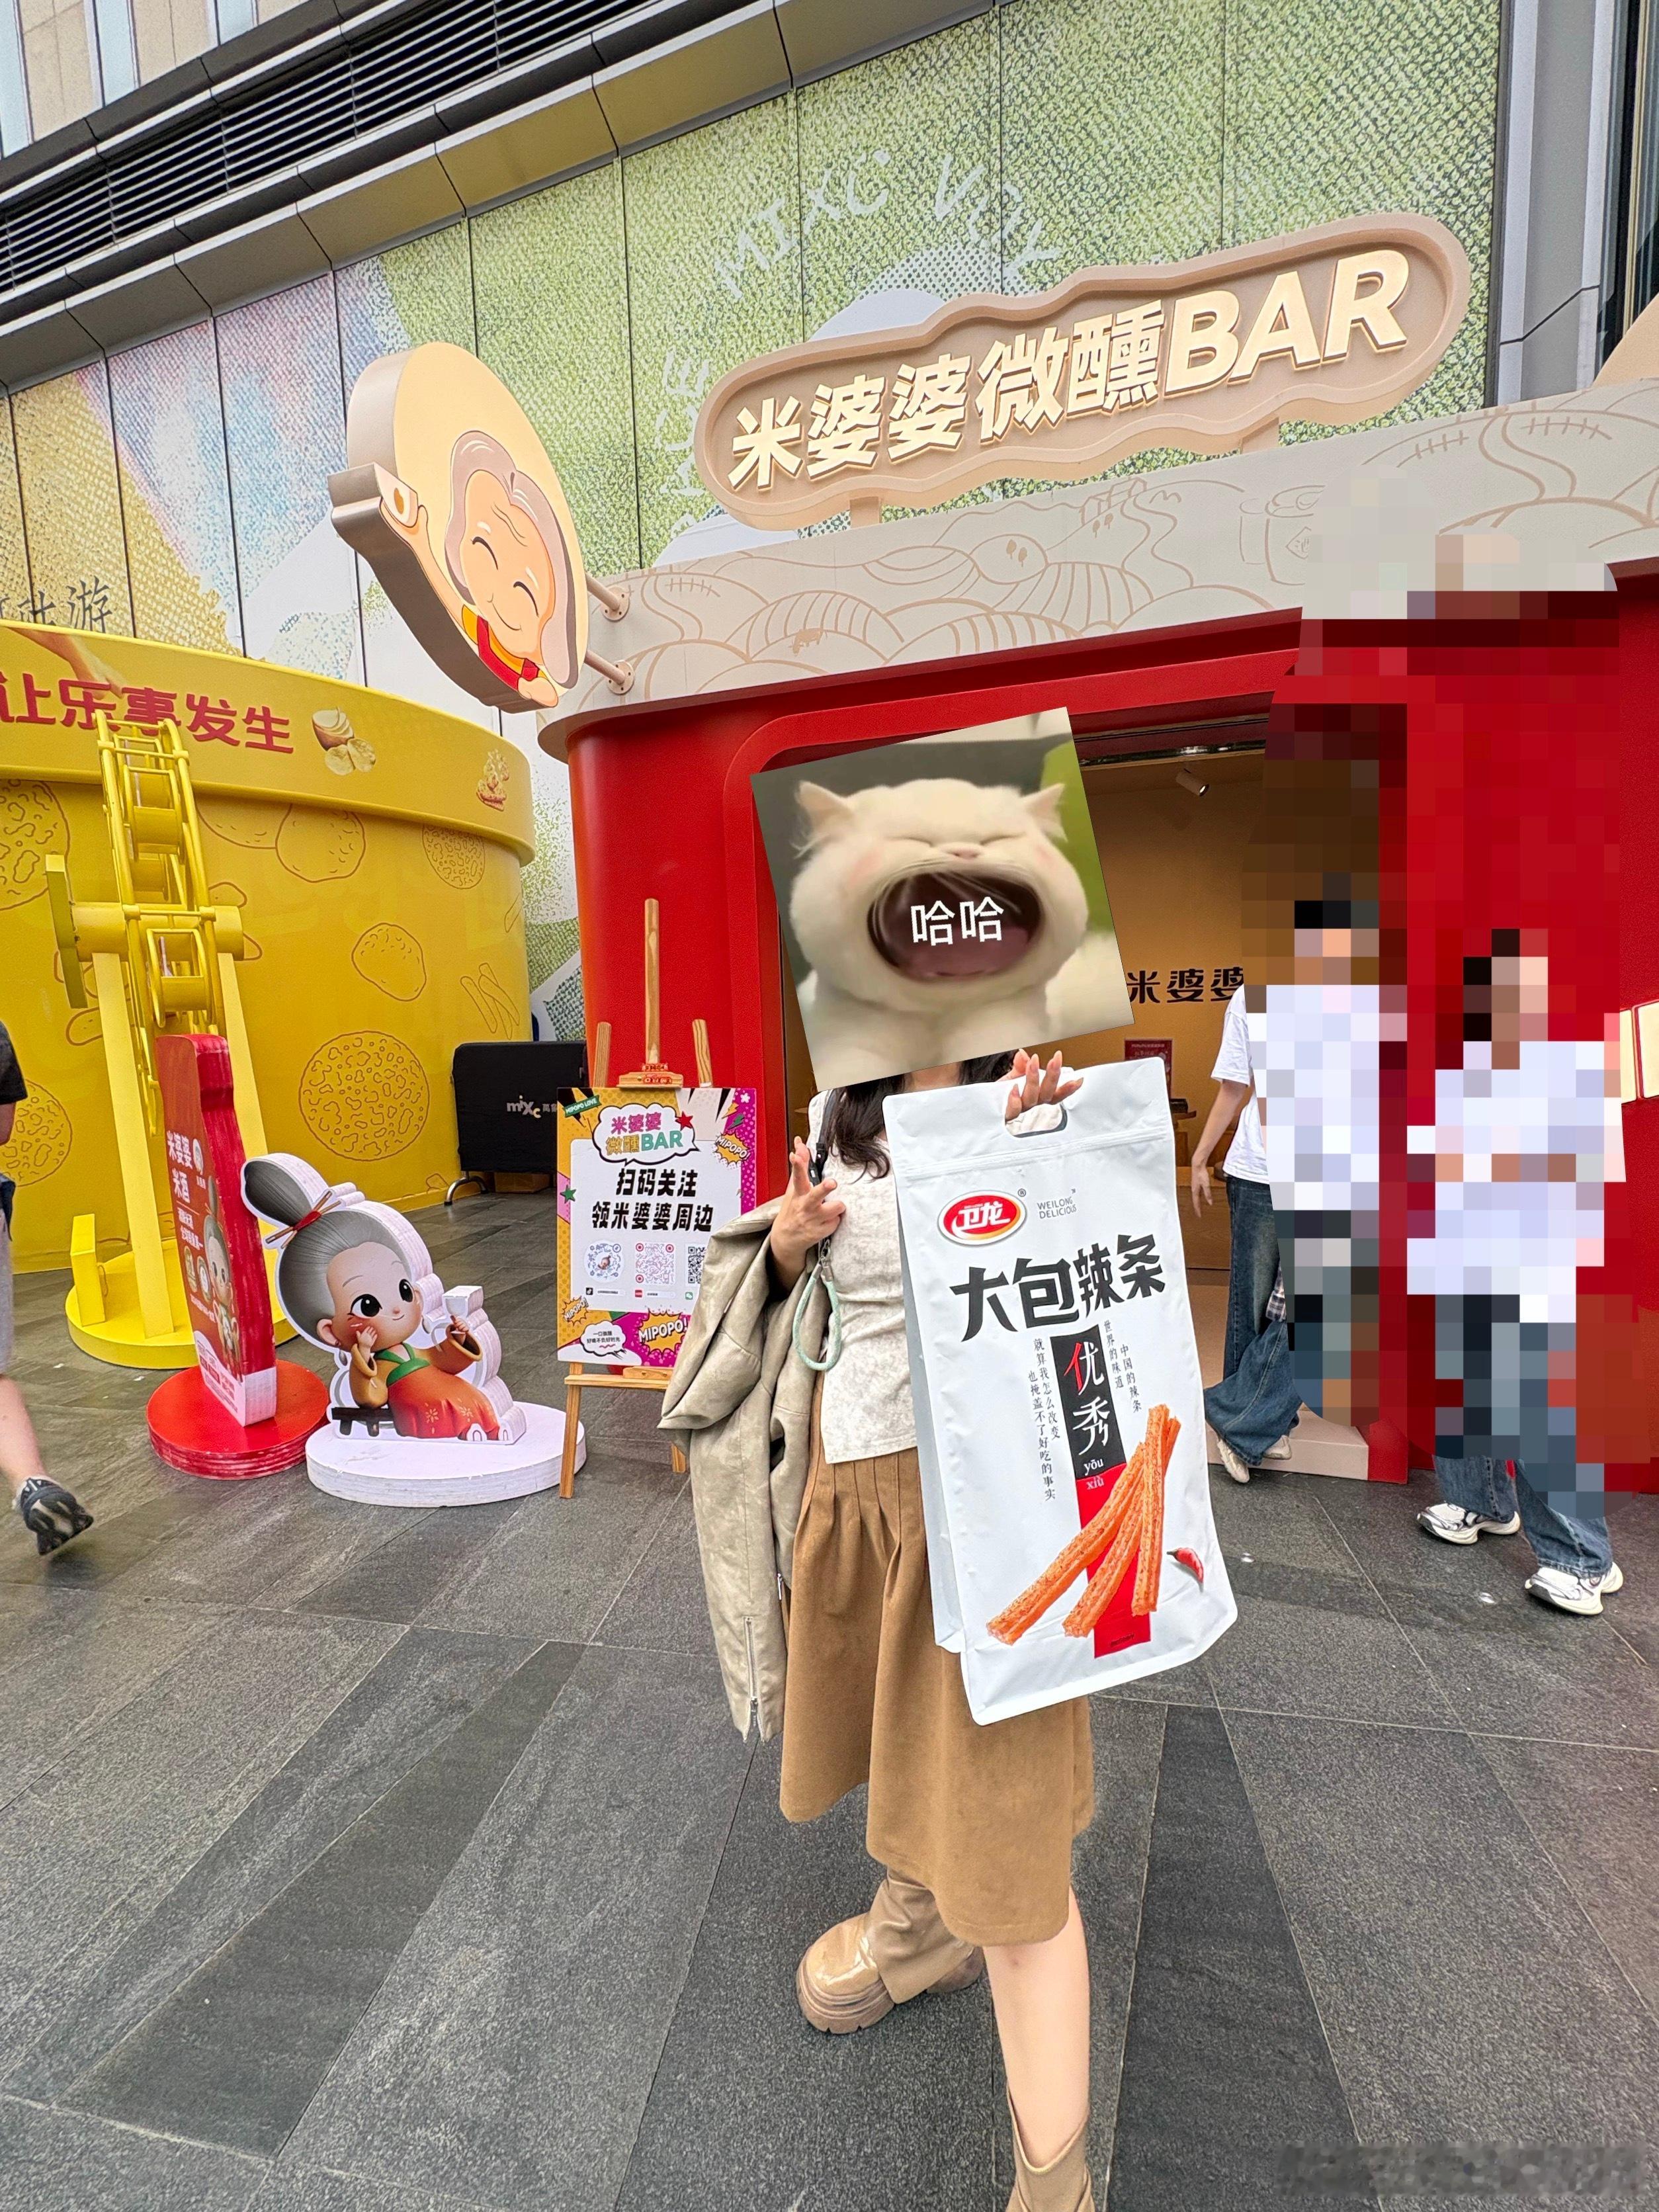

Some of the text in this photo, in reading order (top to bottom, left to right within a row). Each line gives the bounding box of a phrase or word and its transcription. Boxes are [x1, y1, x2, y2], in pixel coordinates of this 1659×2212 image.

[727, 249, 1410, 491] 米婆婆微醺BAR
[0, 671, 294, 755] 让乐事发生
[1126, 966, 1244, 1004] 米婆婆
[584, 1097, 597, 1107] LOVE
[611, 1111, 662, 1135] 米婆婆
[167, 1130, 193, 1170] 米婆婆
[605, 1130, 683, 1156] 微醺BAR
[716, 1135, 751, 1161] MIPOPO!
[616, 1168, 699, 1197] 扫码关注
[592, 1201, 714, 1232] 领米婆婆周边
[955, 1201, 1011, 1233] 卫龙
[1037, 1196, 1073, 1211] WEILONG
[1039, 1203, 1077, 1219] DELICIOUS
[949, 1234, 1166, 1343] 大包辣条
[638, 1316, 689, 1343] MIPOPO!
[1103, 1319, 1124, 1389] 世界的味道
[1033, 1338, 1060, 1441] 就算我怎么改变
[1120, 1343, 1142, 1414] 中国的辣条
[1063, 1341, 1110, 1455] 优秀
[1028, 1370, 1056, 1502] 也掩盖不了好吃的事实
[1083, 1459, 1104, 1476] yōu
